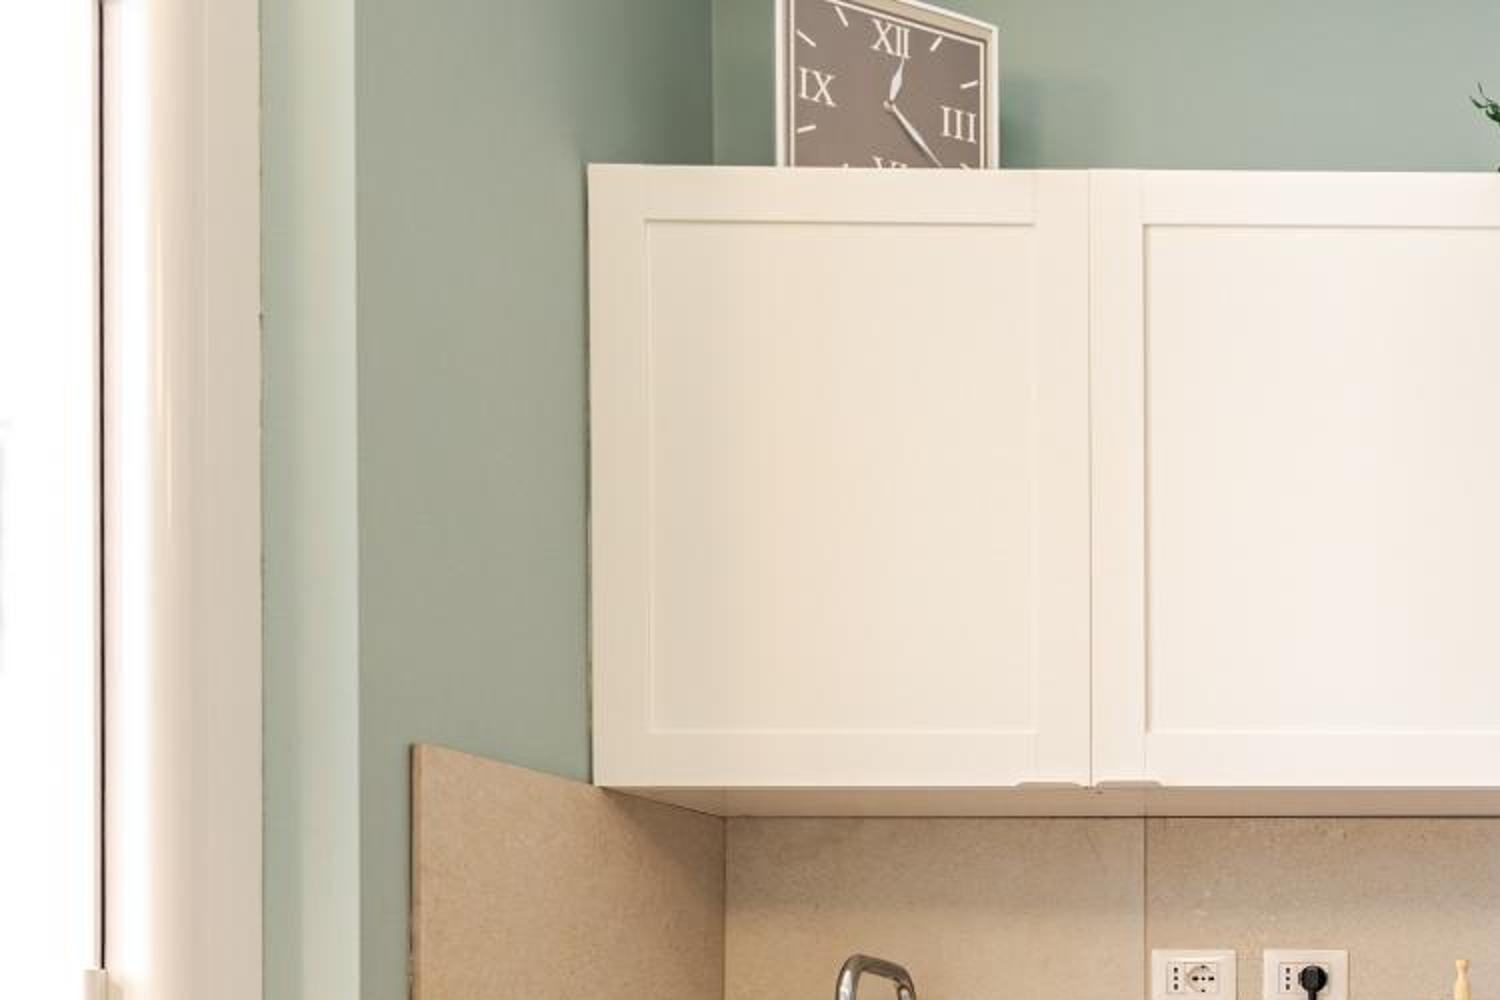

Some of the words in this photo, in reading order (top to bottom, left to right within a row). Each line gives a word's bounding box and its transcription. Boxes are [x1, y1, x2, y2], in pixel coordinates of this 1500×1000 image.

[871, 18, 911, 59] XII
[799, 66, 837, 107] IX
[940, 105, 977, 143] III
